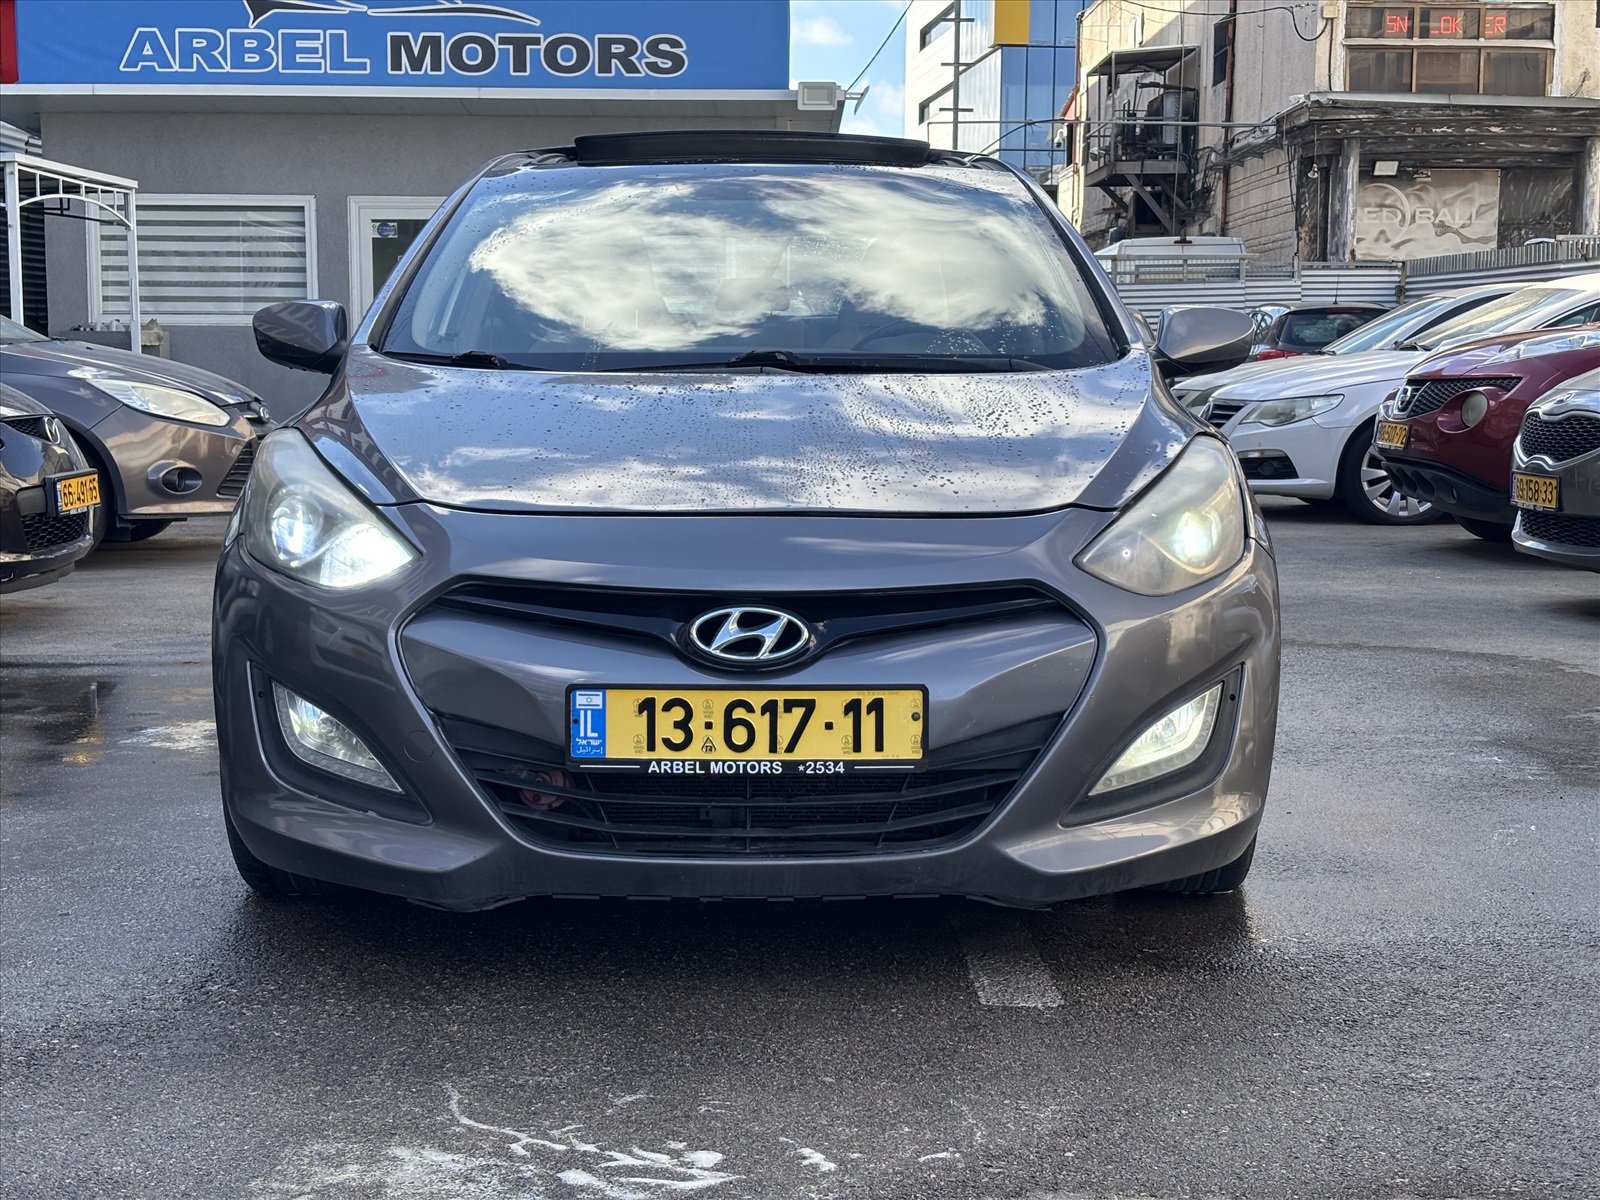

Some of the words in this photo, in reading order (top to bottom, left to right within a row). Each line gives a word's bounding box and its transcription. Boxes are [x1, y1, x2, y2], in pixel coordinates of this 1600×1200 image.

[119, 27, 370, 74] ARBEL
[387, 31, 688, 78] MOTORS
[1358, 207, 1402, 224] ED
[1415, 207, 1487, 224] BALL
[580, 709, 599, 738] IL
[575, 737, 603, 746] ישראל
[575, 746, 603, 755] إسرائيل
[648, 761, 706, 774] ARBEL
[710, 761, 783, 774] MOTORS
